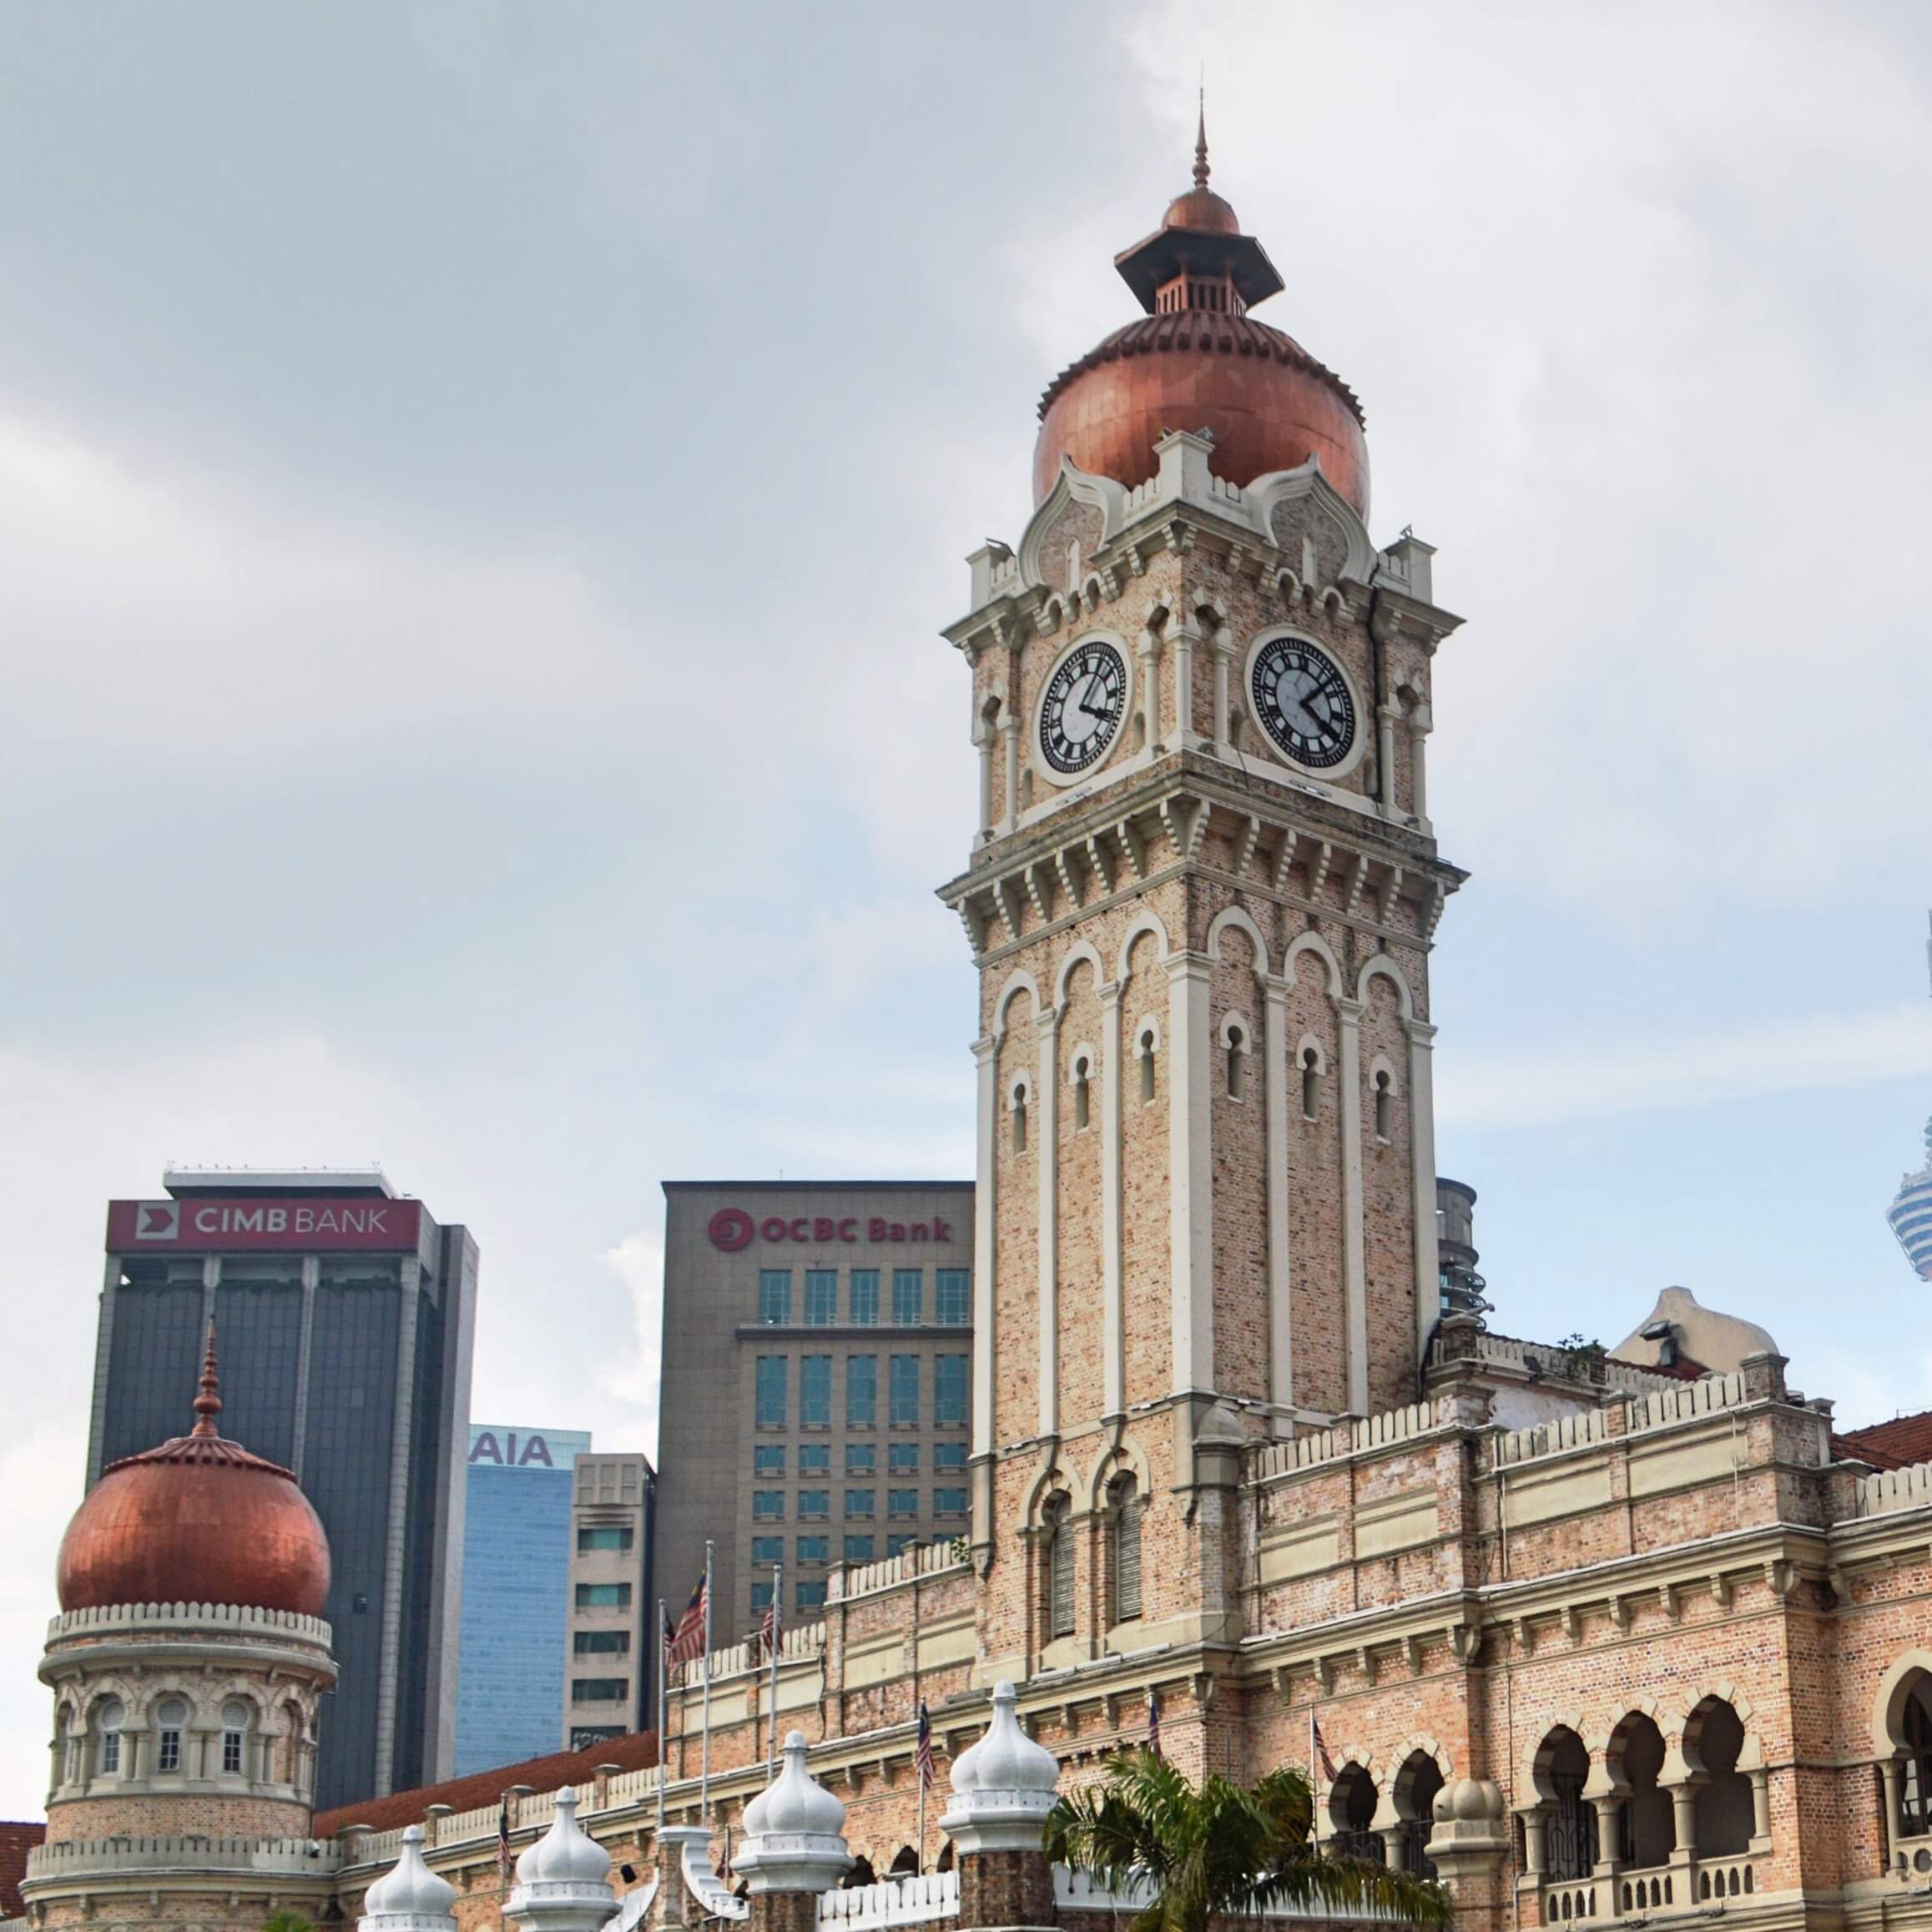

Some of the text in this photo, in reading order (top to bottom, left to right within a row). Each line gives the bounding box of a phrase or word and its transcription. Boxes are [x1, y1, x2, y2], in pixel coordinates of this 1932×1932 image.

[194, 1208, 388, 1233] CIMB BANK
[760, 1215, 951, 1243] OCBC Bank
[468, 1432, 554, 1467] AIA
